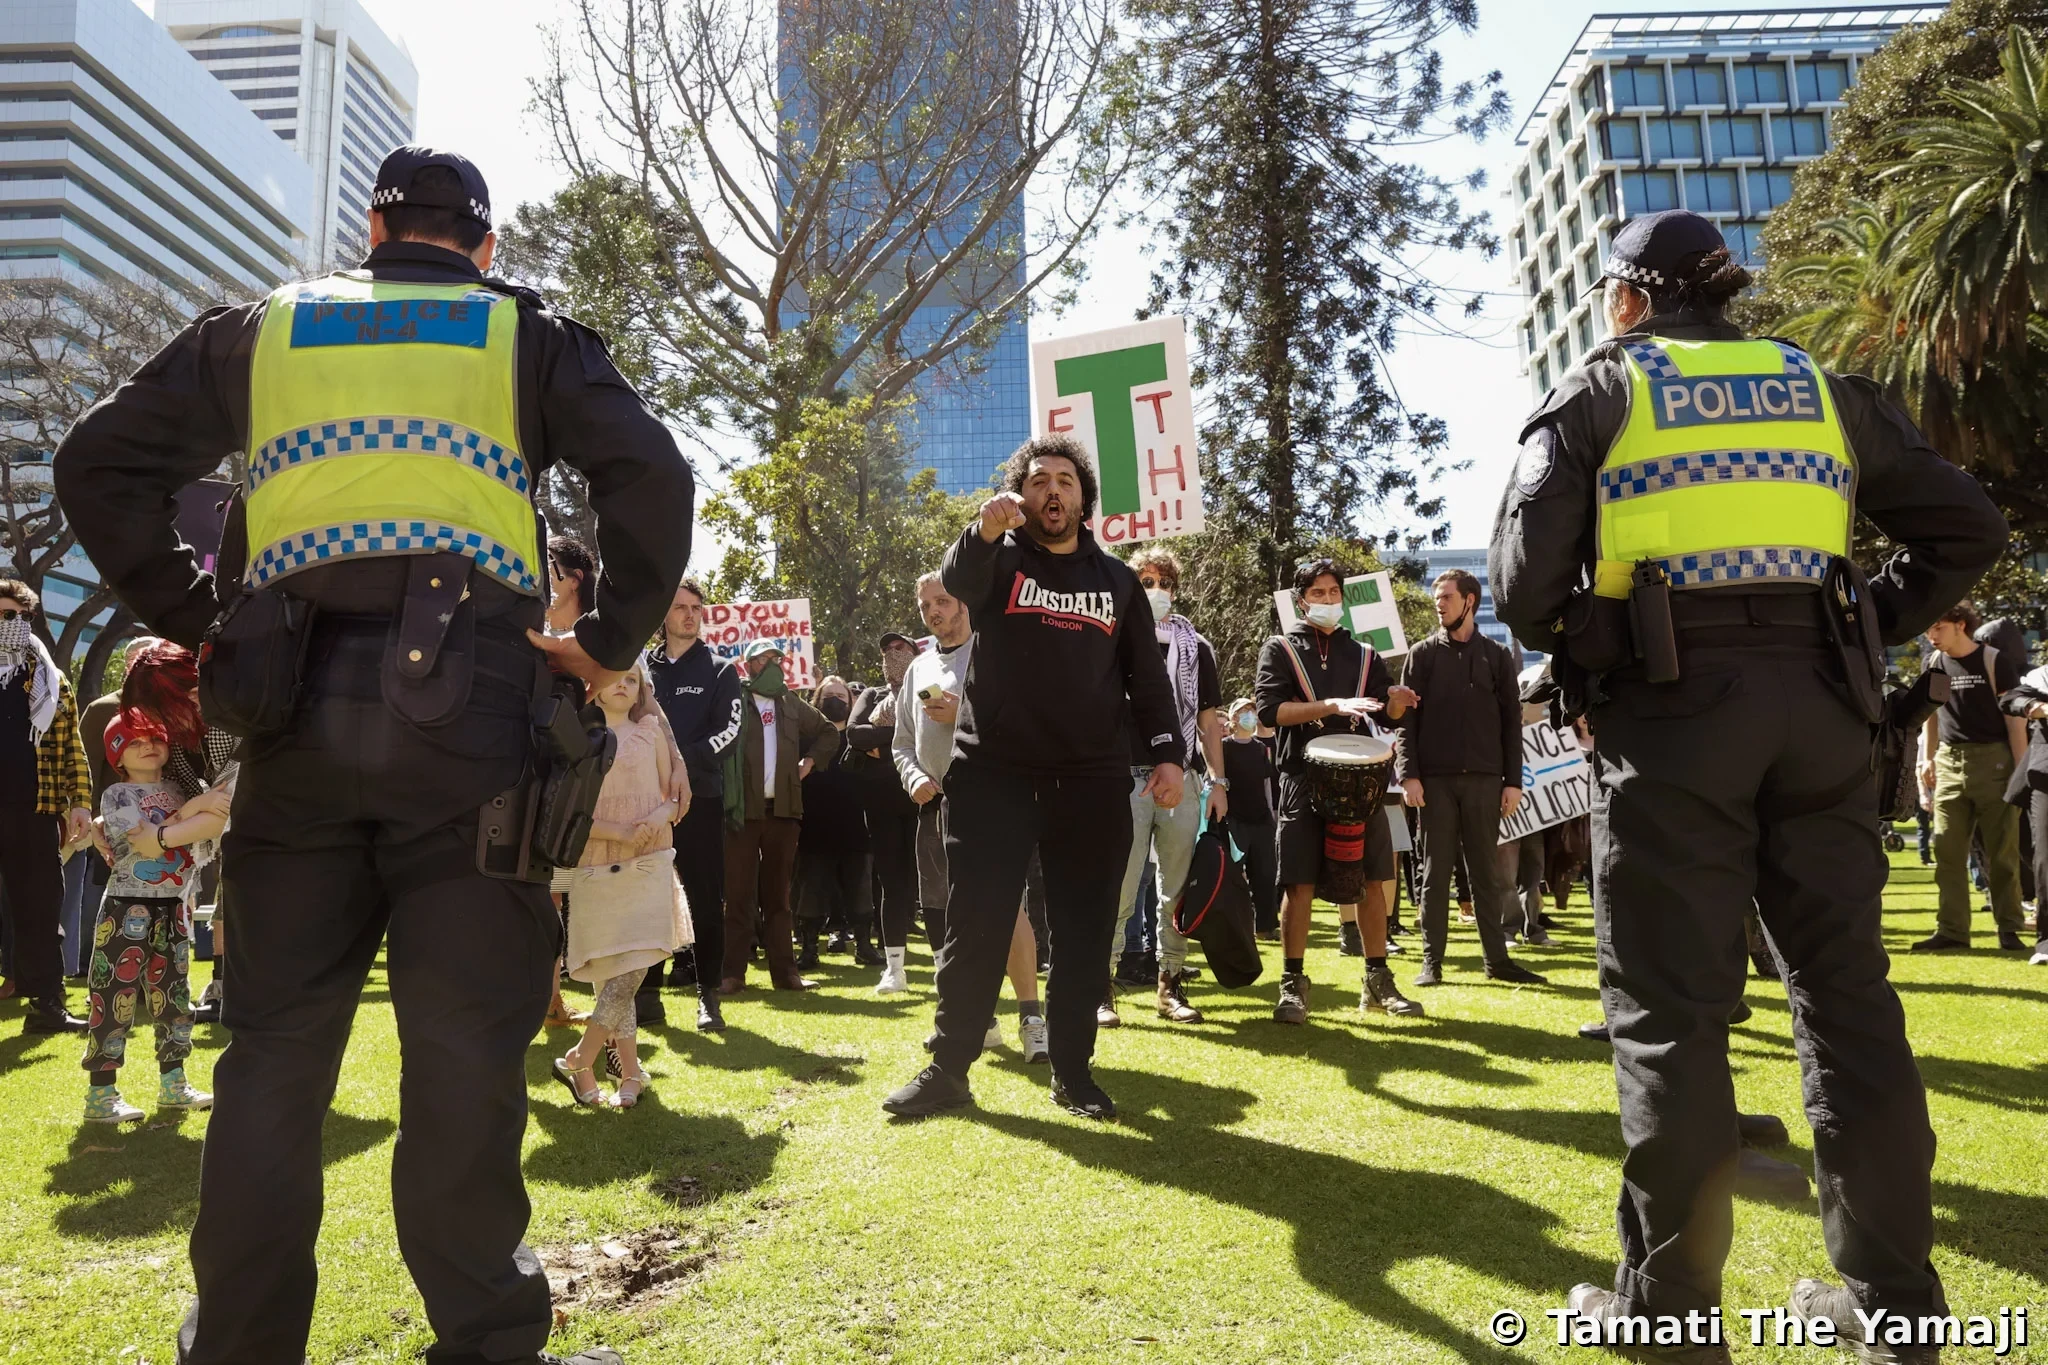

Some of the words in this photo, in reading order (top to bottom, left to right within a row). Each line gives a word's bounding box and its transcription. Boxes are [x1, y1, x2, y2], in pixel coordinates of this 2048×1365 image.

[313, 301, 470, 323] POLICE
[357, 320, 418, 341] N-4
[1661, 379, 1816, 422] POLICE
[1089, 499, 1182, 543] CH!!
[1005, 571, 1117, 636] LONSDALE
[1343, 581, 1379, 606] NOUS
[702, 605, 731, 625] ID
[733, 603, 789, 623] YOU
[1041, 615, 1083, 632] LONDON
[1521, 722, 1576, 763] NCE
[1521, 765, 1535, 788] S
[1499, 771, 1591, 840] OMPLICITY
